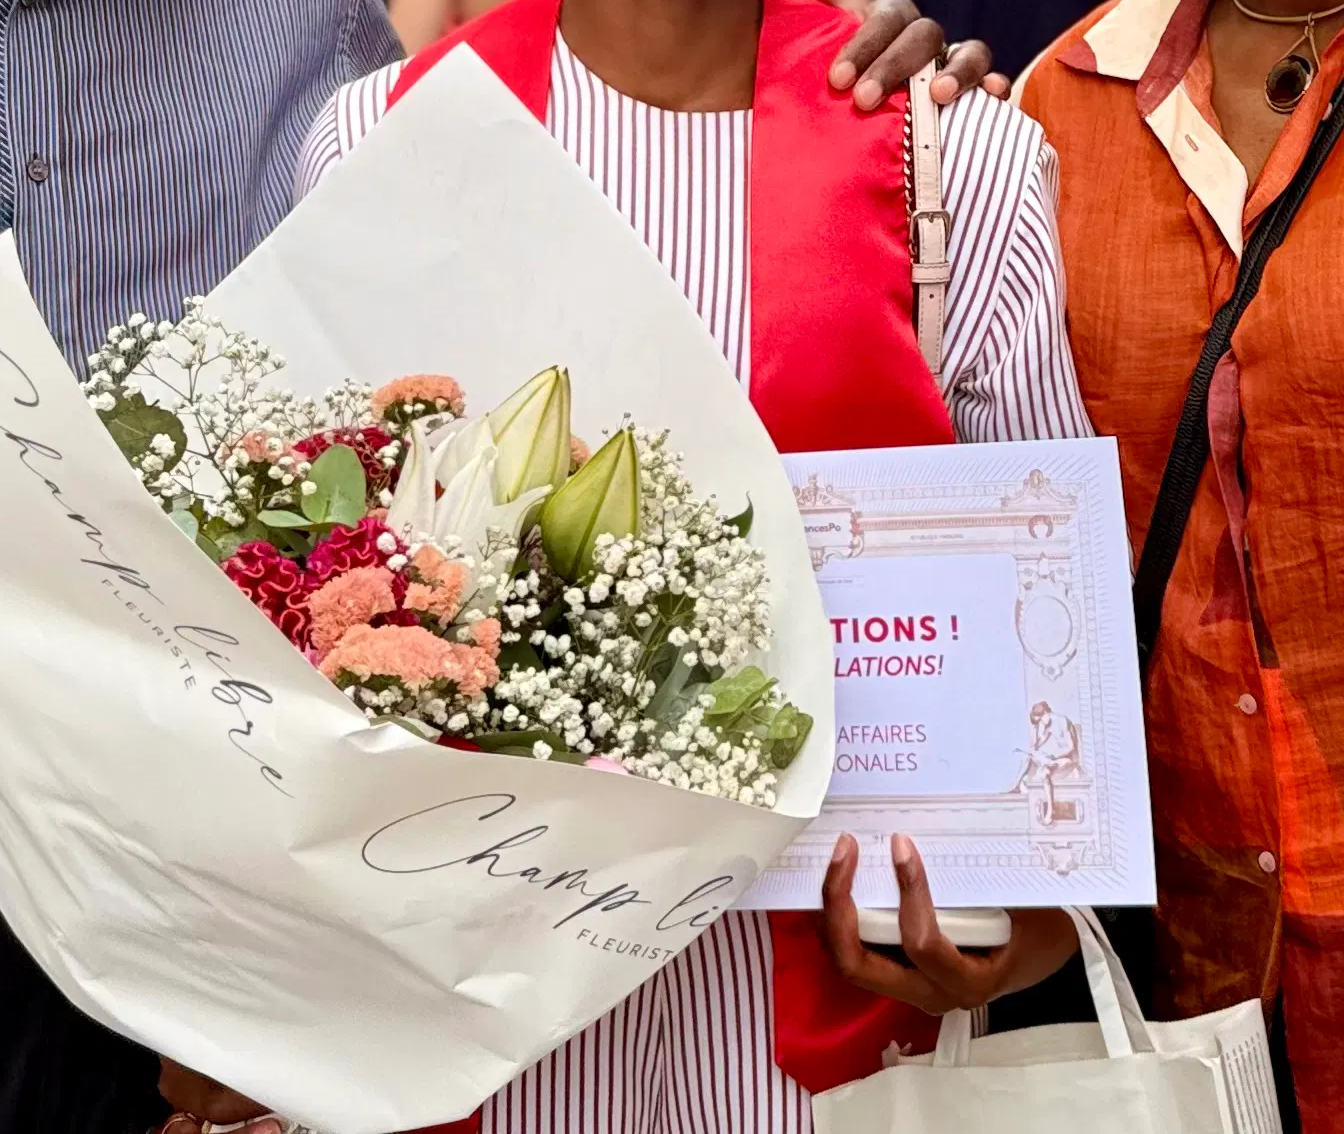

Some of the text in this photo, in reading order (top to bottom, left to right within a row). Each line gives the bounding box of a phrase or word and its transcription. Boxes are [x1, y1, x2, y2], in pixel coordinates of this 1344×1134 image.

[101, 578, 198, 692] FLEURISTE
[173, 624, 296, 801] libre
[831, 752, 919, 773] ONALES
[836, 723, 928, 744] AFFAIRES
[360, 792, 653, 930] Champ
